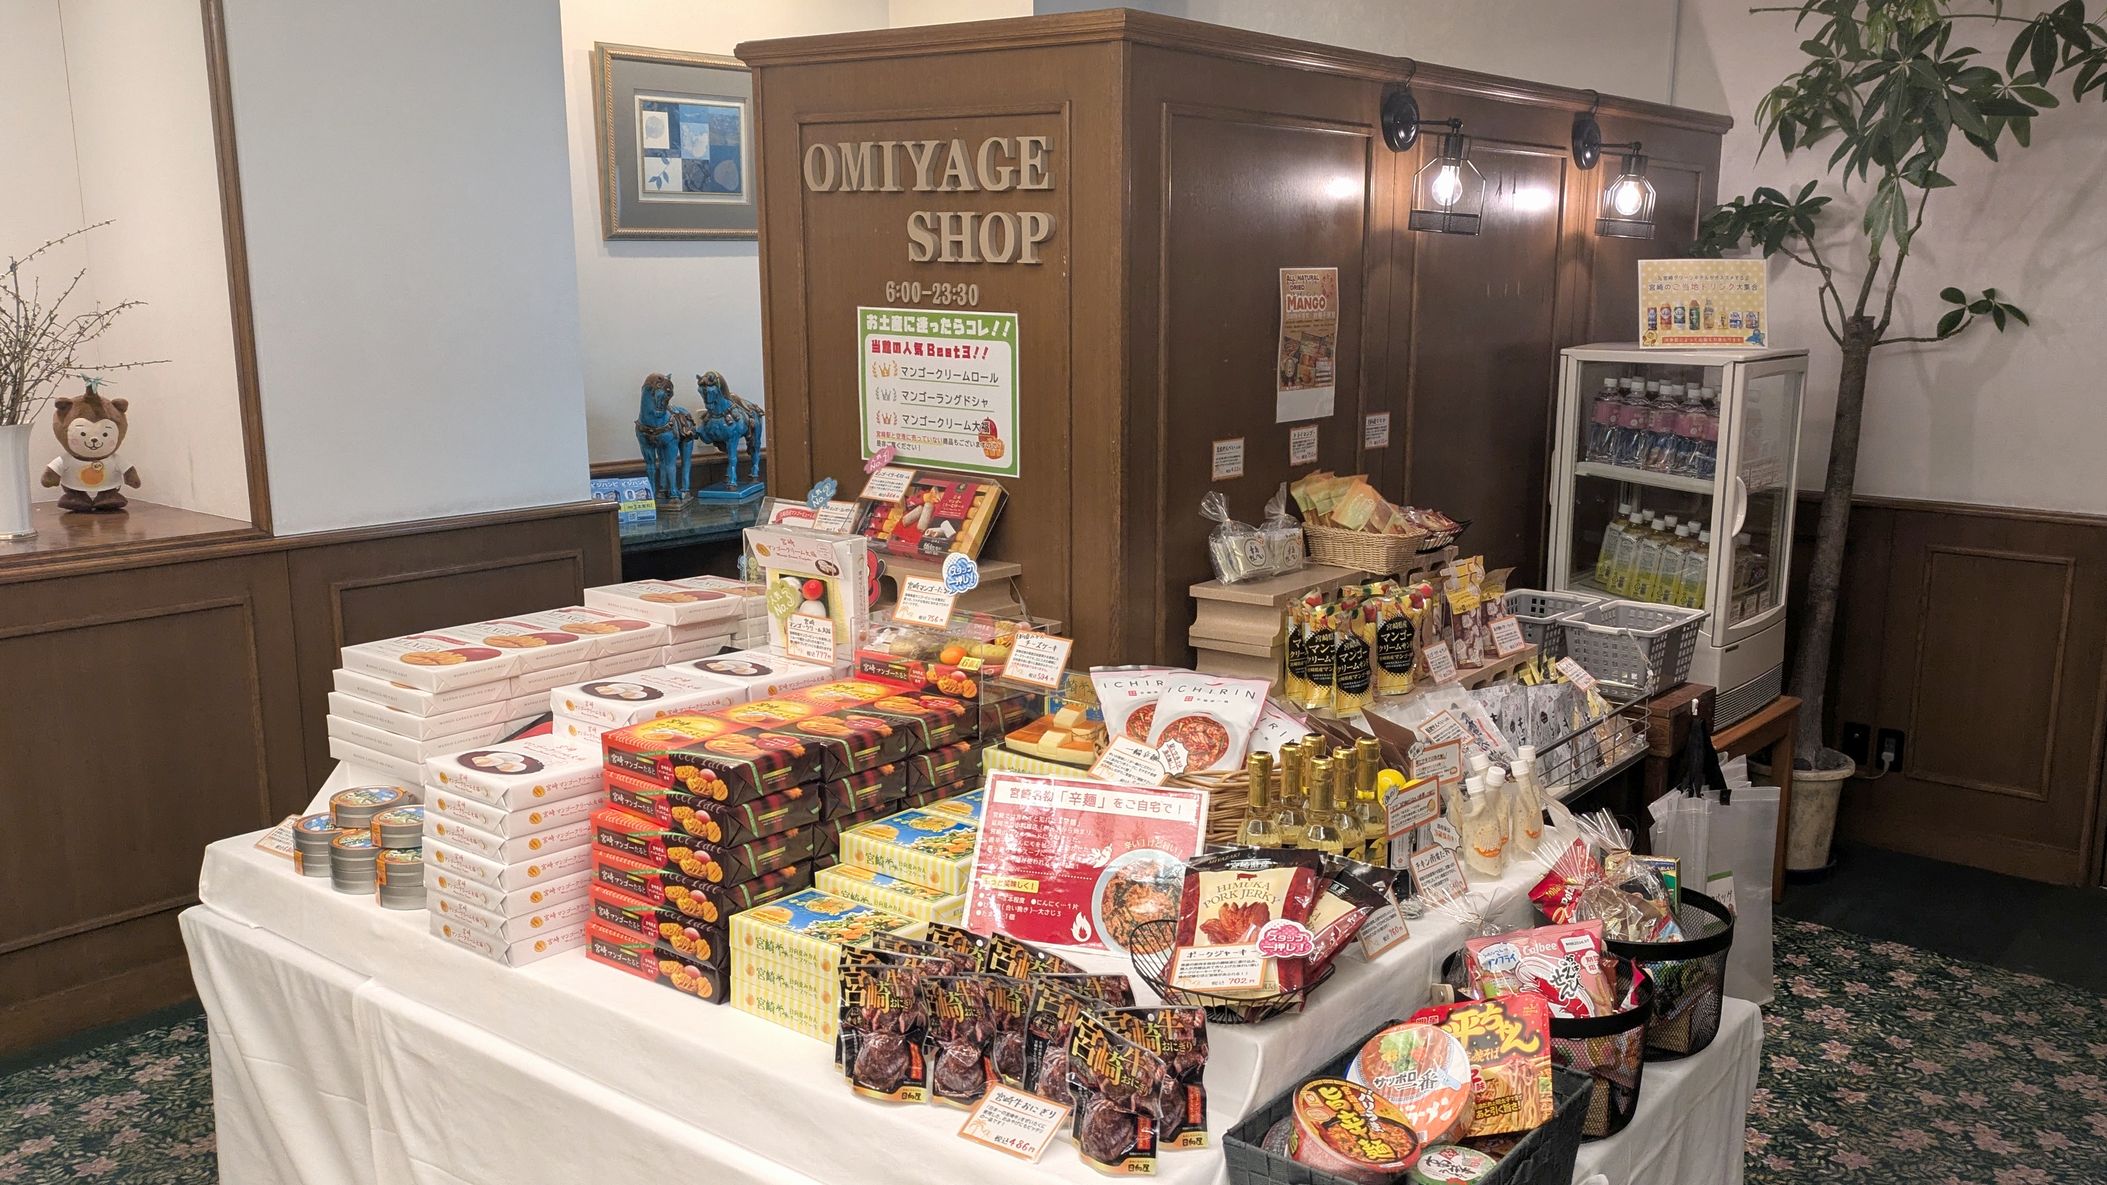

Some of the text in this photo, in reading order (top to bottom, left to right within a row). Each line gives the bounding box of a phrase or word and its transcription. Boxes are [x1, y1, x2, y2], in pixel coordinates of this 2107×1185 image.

[803, 135, 1055, 192] OMIYAGE
[906, 210, 1056, 264] SHOP
[1297, 273, 1319, 281] NATURAL
[1286, 295, 1326, 311] MANGO
[900, 366, 999, 384] マンゴークリームロール
[901, 390, 988, 407] マンゴーラングドシャ
[902, 414, 990, 433] マンゴークリーム大福
[1380, 629, 1413, 642] マンゴー
[1338, 647, 1368, 662] マンゴー
[1167, 684, 1257, 701] ICHIRIN
[610, 752, 656, 776] 宮崎マンゴーたると
[611, 790, 654, 815] 宮崎マンゴーたると
[600, 832, 648, 856] 宮崎マンゴーたると
[866, 852, 885, 868] 宮崎
[601, 868, 646, 894] 宮崎マンゴーたると
[1216, 880, 1271, 893] HIMUKA
[841, 889, 861, 903] 宮崎
[1203, 888, 1281, 909] PORK JERKY
[756, 936, 775, 954] 宮崎
[1268, 932, 1304, 942] スタッフ
[1263, 942, 1304, 952] 一押し!
[1522, 942, 1558, 956] Calbee
[757, 967, 775, 985] 宮崎
[757, 996, 775, 1015] 宮崎
[1071, 1016, 1141, 1086] 宮崎牛
[1162, 1041, 1193, 1053] おにぎり
[994, 1092, 1057, 1119] 宮崎牛おにぎり
[1475, 1100, 1521, 1119] あと引く旨さ!
[1318, 1086, 1398, 1161] 旨辛麺
[994, 1135, 1036, 1153] 税込486円
